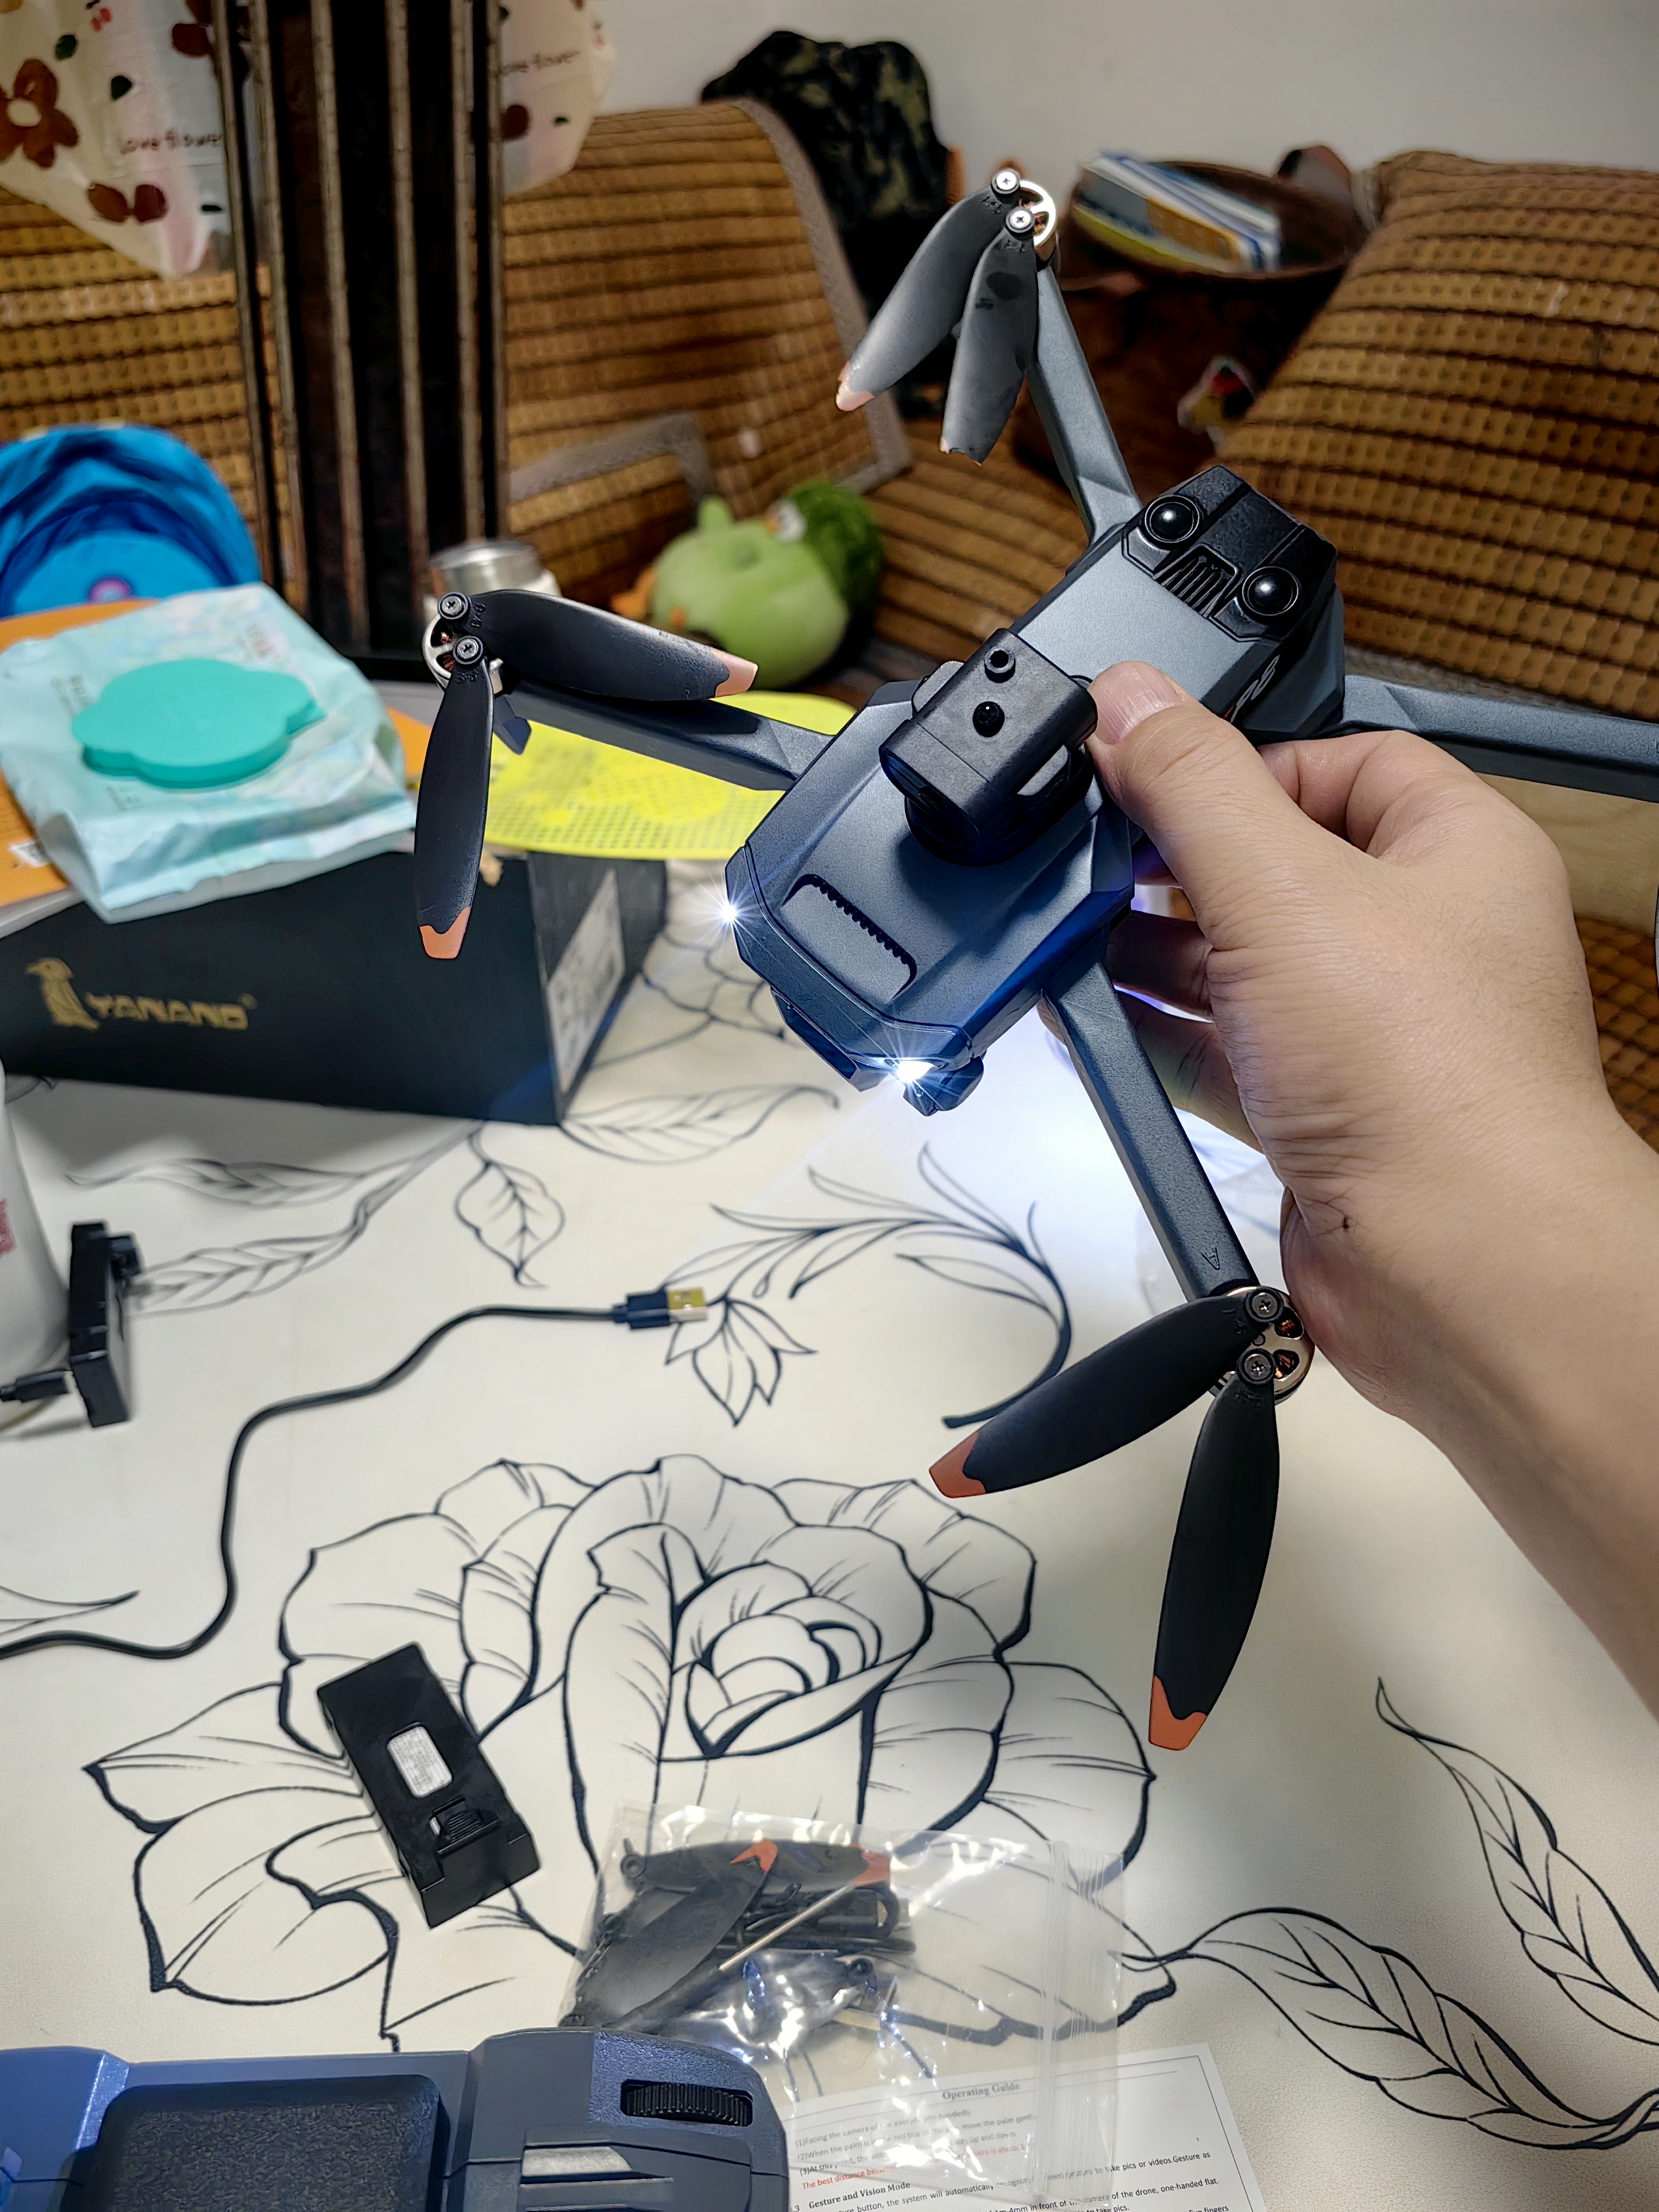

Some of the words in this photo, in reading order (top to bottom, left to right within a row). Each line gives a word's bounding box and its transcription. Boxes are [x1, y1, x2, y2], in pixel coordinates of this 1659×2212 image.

[942, 2086, 990, 2101] Operating
[830, 2145, 843, 2154] the
[844, 2140, 863, 2152] palm
[983, 2119, 995, 2127] the
[801, 2181, 816, 2190] The
[817, 2177, 833, 2186] best
[834, 2170, 865, 2182] distance
[886, 2199, 899, 2207] the
[901, 2194, 927, 2205] system
[929, 2189, 943, 2199] will
[1122, 2162, 1137, 2172] pics
[808, 2198, 841, 2209] Gesture
[843, 2191, 859, 2201] and
[860, 2187, 886, 2197] Vision
[887, 2182, 911, 2192] Mode
[1030, 2203, 1037, 2211] in
[1039, 2201, 1058, 2210] front
[1112, 2192, 1119, 2200] of
[1121, 2190, 1134, 2199] the
[1160, 2179, 1203, 2193] one-handed
